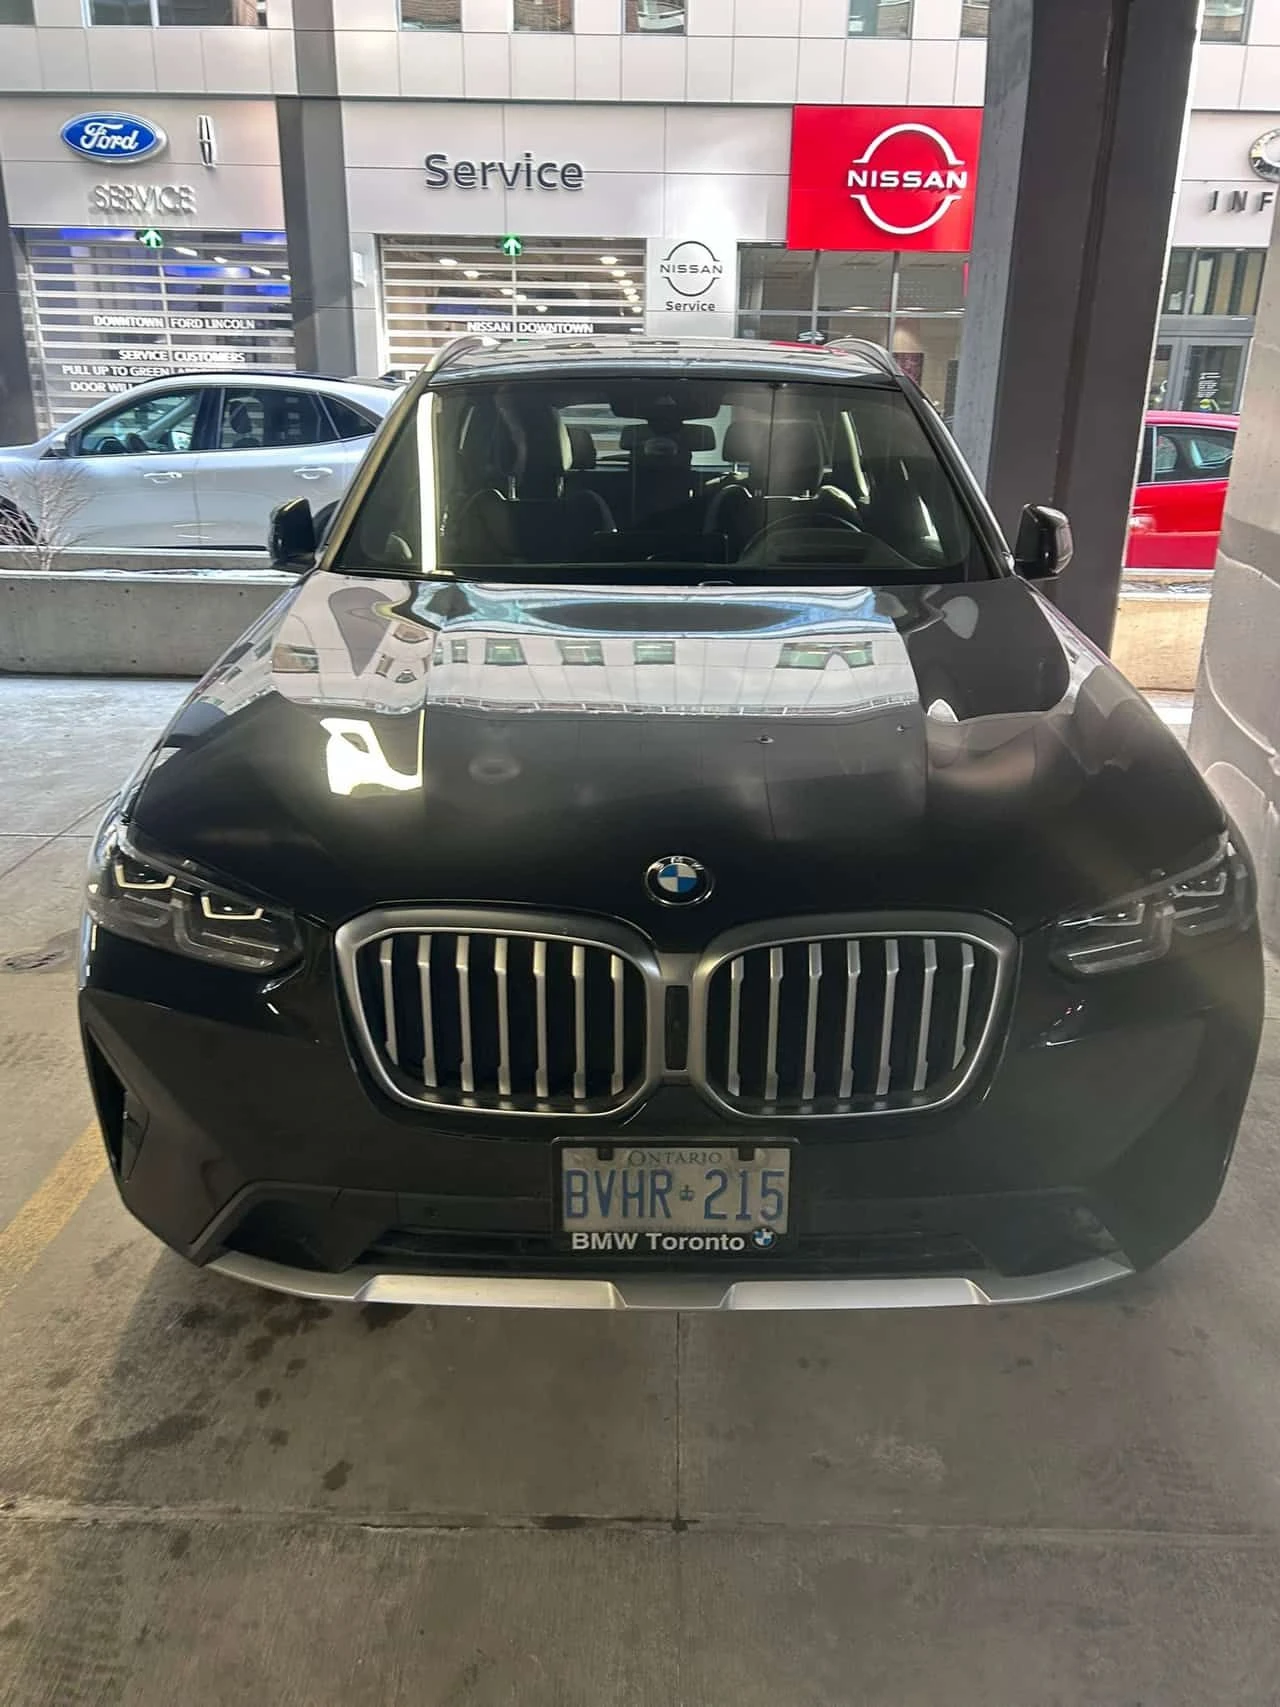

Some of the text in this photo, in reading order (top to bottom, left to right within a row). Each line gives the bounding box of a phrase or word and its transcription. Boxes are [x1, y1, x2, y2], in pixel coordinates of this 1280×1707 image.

[80, 122, 140, 150] Ford
[424, 153, 584, 188] Service
[847, 170, 968, 188] NISSAN
[94, 183, 198, 213] SERVICE
[659, 264, 723, 275] NISSAN
[665, 300, 716, 312] Service
[93, 315, 255, 330] DOWNTOWN FORD LINCOLN
[467, 321, 594, 334] NISSAN DOWNTOWN
[119, 350, 246, 362] SERVICE CUSTOMERS
[62, 365, 91, 375] PULL
[92, 366, 109, 376] UP
[110, 366, 128, 376] TO
[130, 367, 170, 377] GREEN
[70, 382, 106, 392] DOOR
[628, 1150, 722, 1166] ONTARIO
[565, 1168, 785, 1221] BVHR 215
[572, 1232, 745, 1250] BMW Toronto
